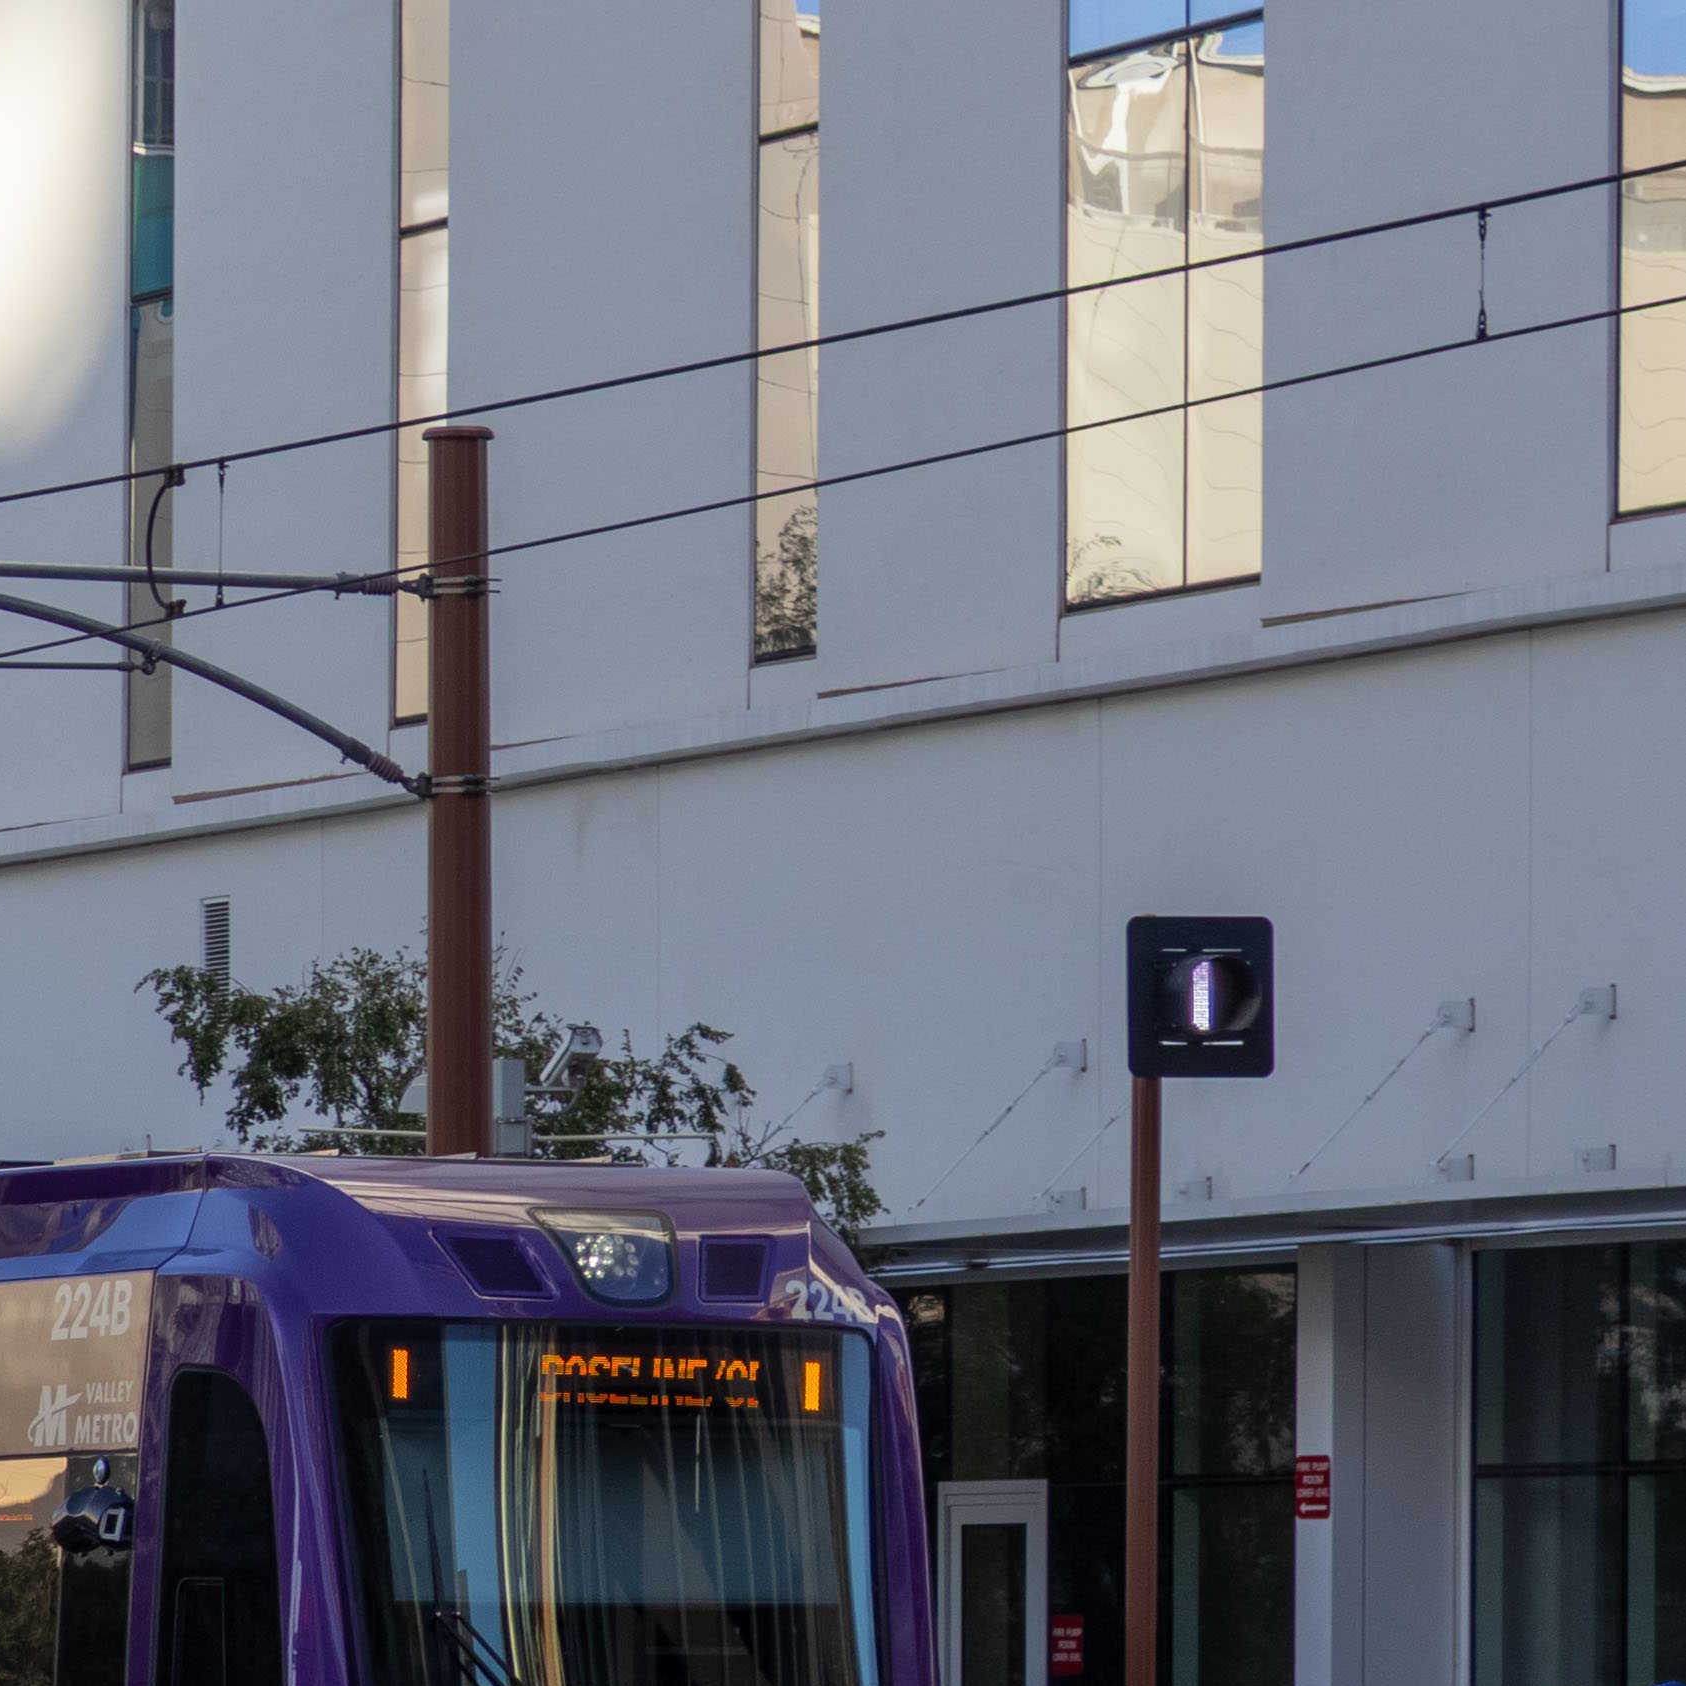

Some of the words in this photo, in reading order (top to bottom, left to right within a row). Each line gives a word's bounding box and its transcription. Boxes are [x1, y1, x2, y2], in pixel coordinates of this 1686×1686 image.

[51, 1279, 132, 1341] 224B
[785, 1280, 878, 1324] 224B
[86, 1380, 134, 1404] VALLEY
[74, 1411, 137, 1445] METRO
